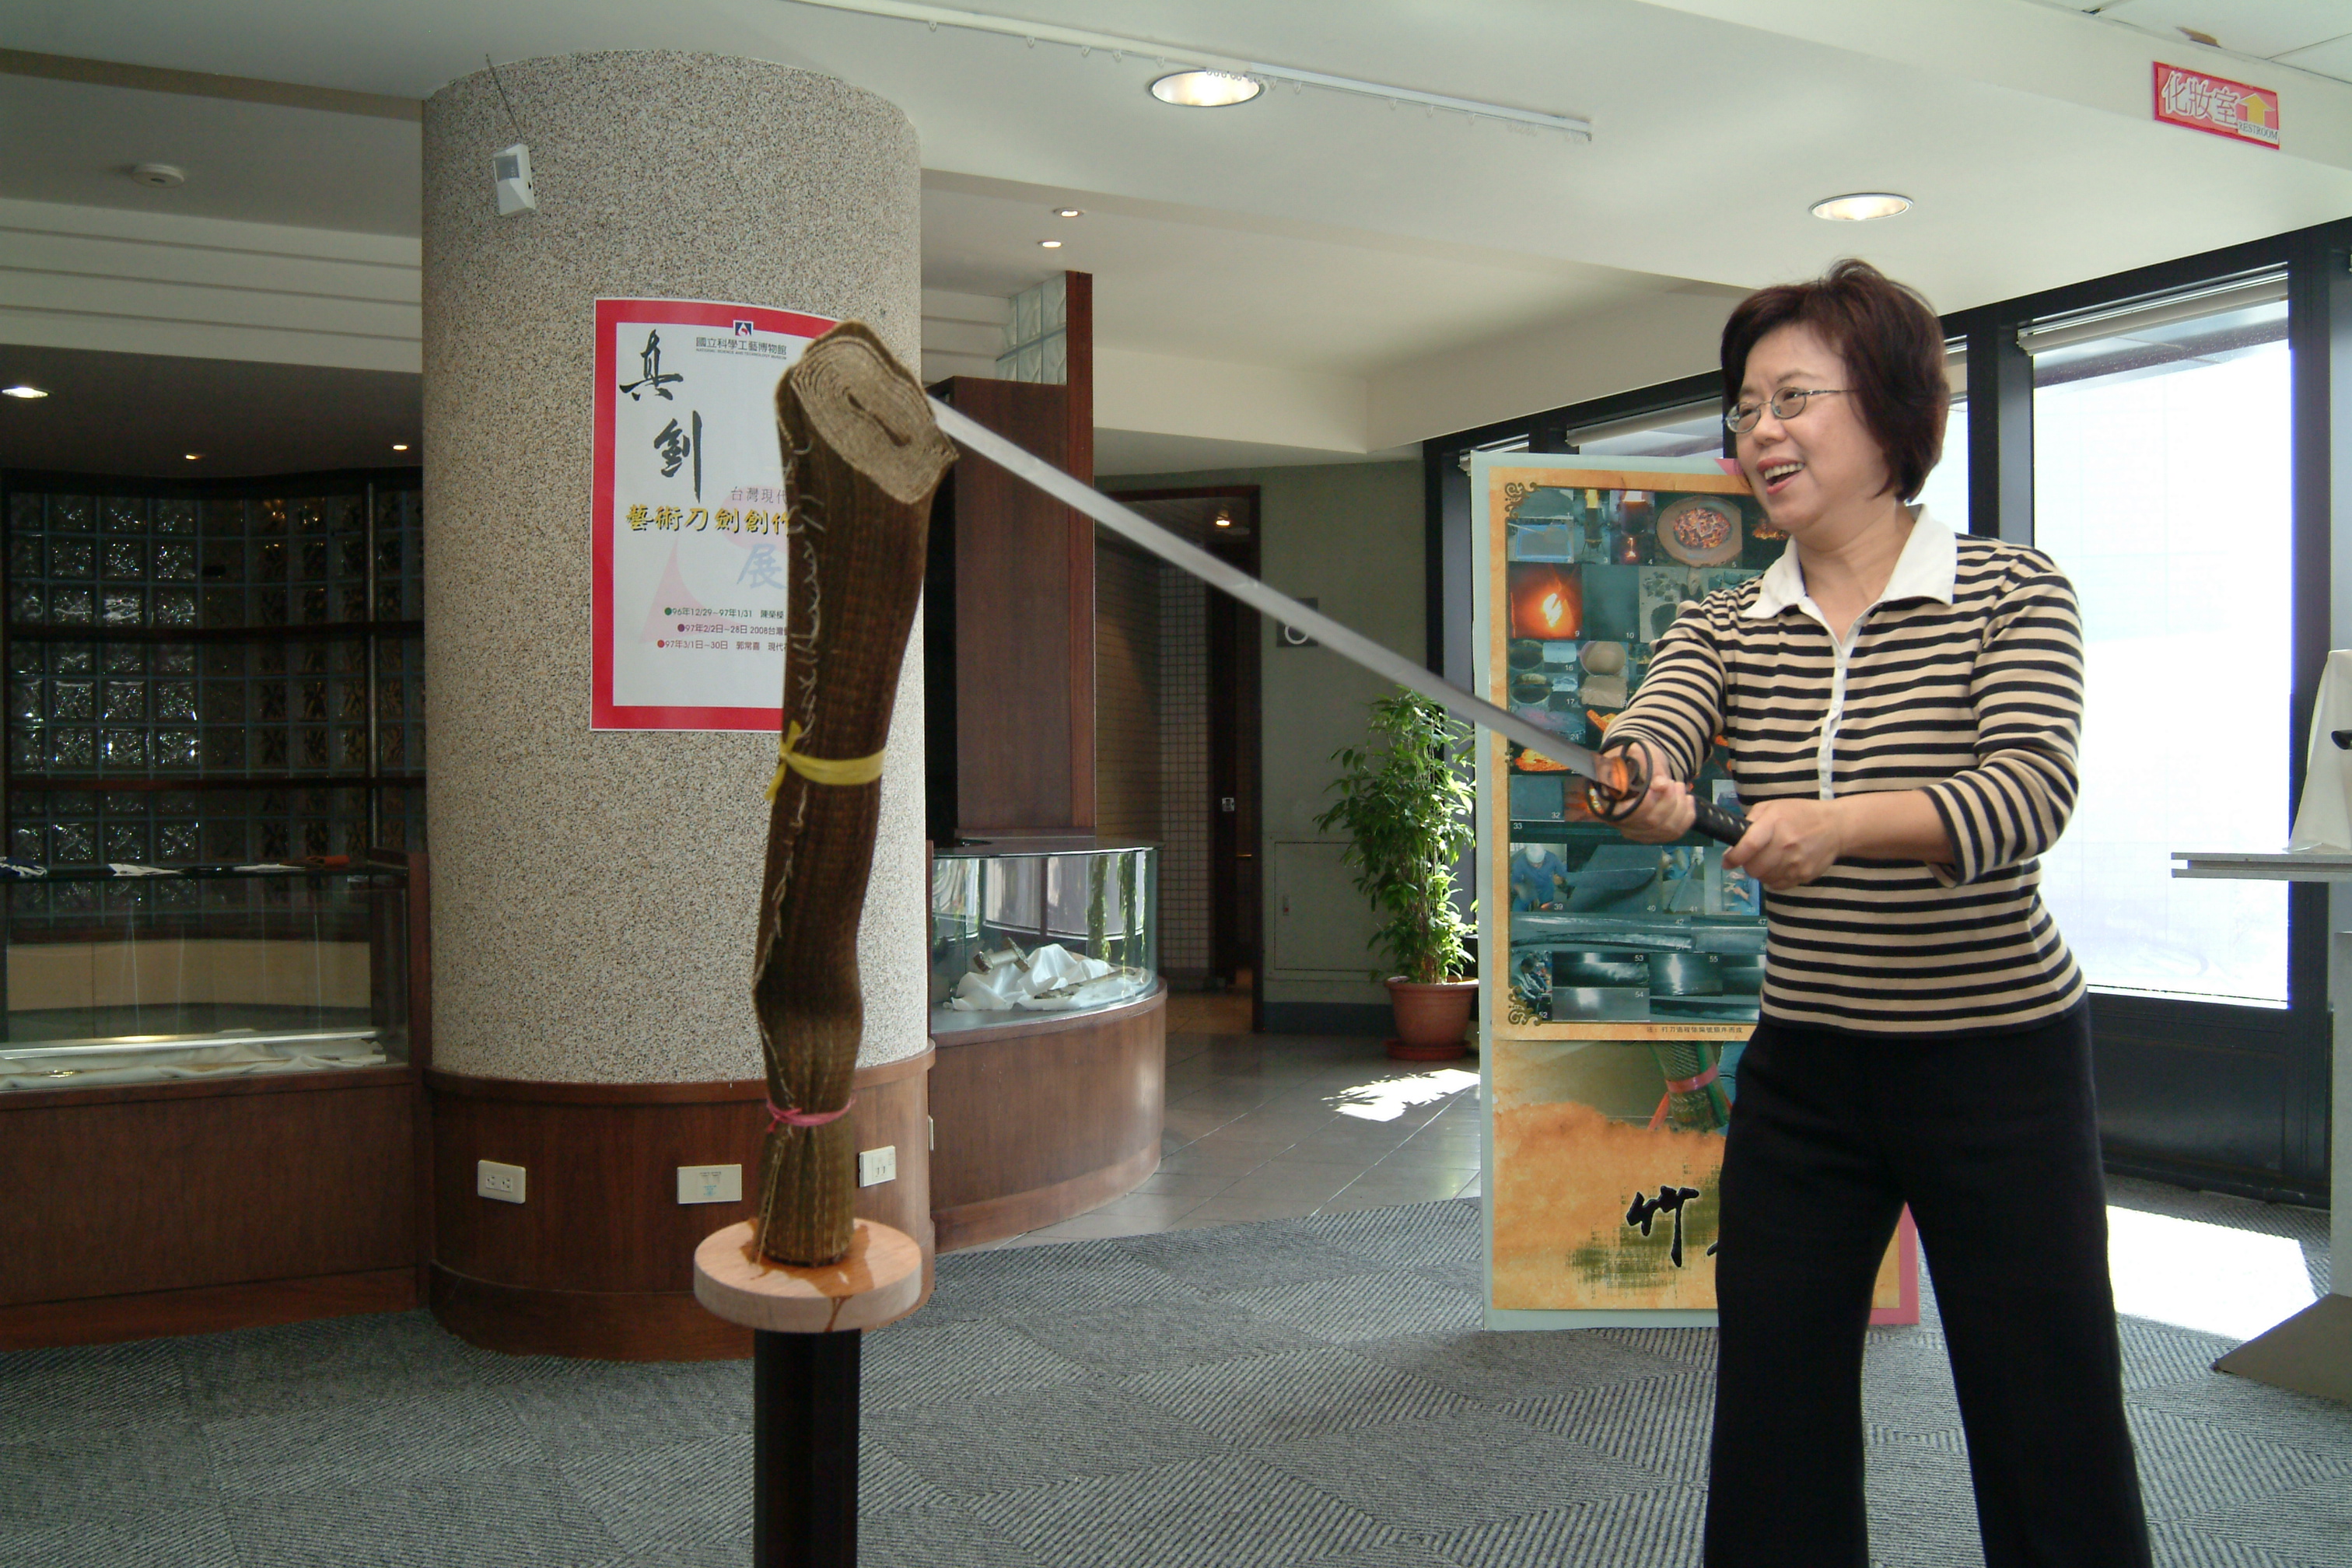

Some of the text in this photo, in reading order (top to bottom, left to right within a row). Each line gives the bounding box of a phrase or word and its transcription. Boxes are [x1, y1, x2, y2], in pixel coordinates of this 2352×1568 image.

[2162, 71, 2240, 128] 化妝室
[2238, 121, 2278, 140] RESTROOM
[696, 337, 786, 355] 國立科學工藝博物館
[737, 544, 786, 589] 展
